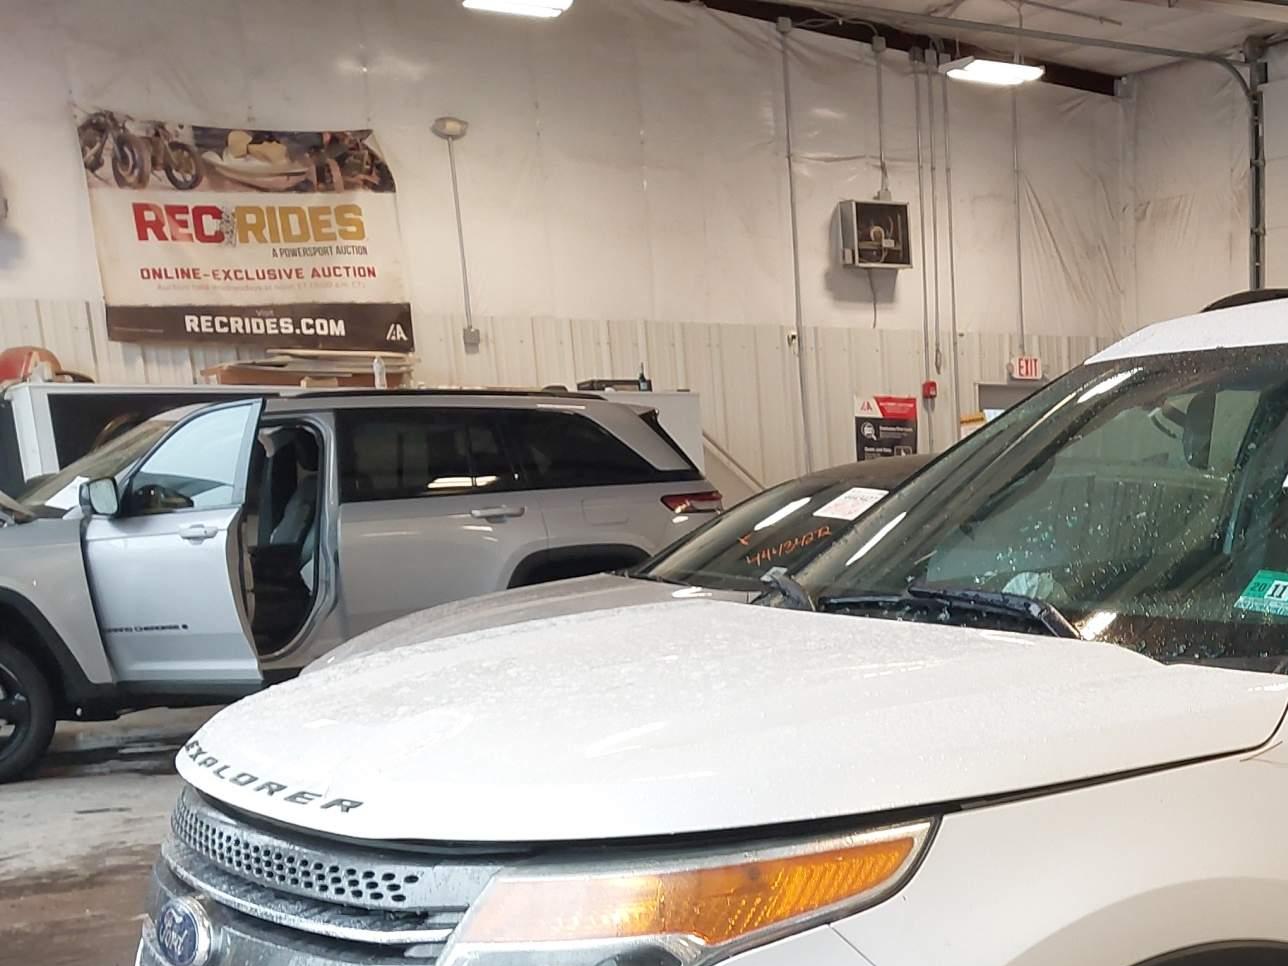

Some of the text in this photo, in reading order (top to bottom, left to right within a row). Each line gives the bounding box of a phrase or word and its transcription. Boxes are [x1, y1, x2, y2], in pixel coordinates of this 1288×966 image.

[132, 203, 367, 244] REC RIDES
[272, 245, 368, 258] A POWERSPORT AUCTION
[139, 266, 377, 281] ONLINE-EXCLUSIVE AUCTION
[185, 315, 346, 337] RECRIDES.COM
[1018, 358, 1039, 377] EXIT
[184, 739, 364, 813] EXPLORER
